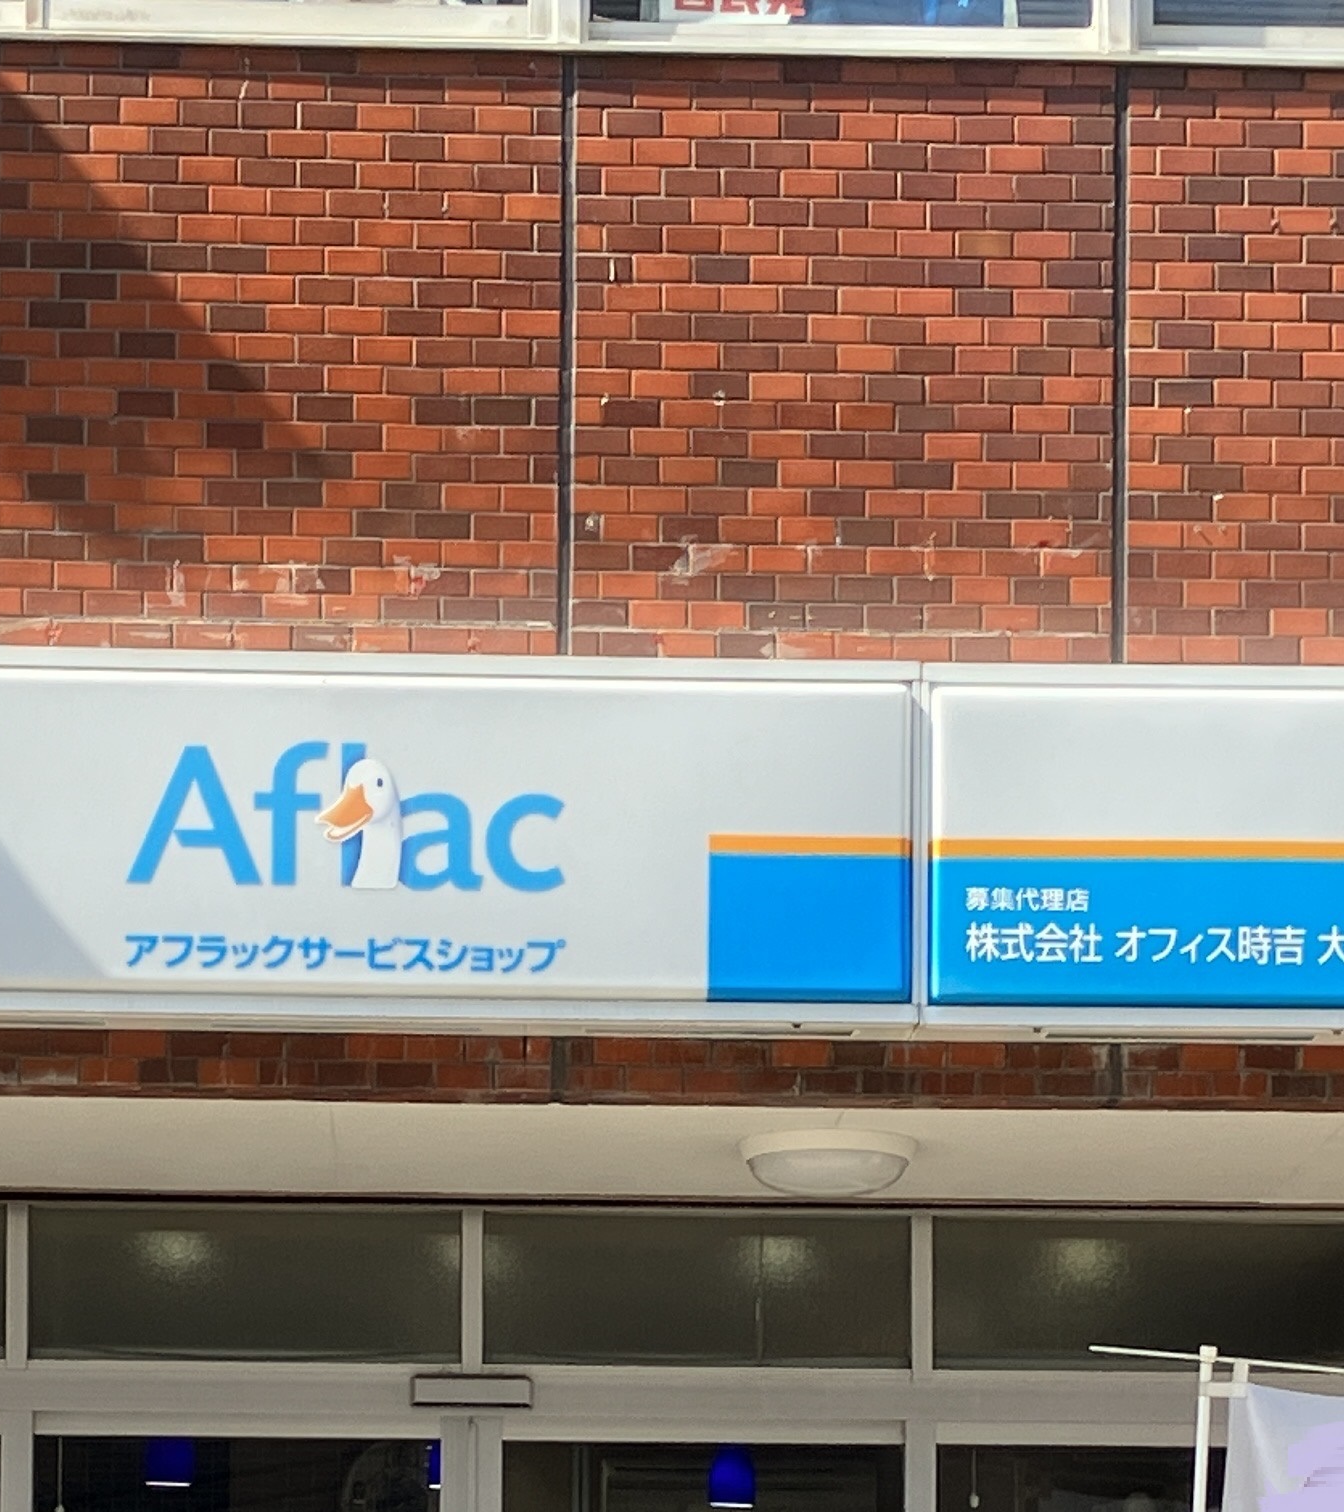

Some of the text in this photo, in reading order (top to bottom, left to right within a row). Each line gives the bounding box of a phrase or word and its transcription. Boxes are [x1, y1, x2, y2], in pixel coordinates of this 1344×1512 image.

[126, 740, 566, 893] Aflac
[964, 886, 1090, 914] 募集代理店
[124, 934, 566, 974] アフラックサービスショップ
[965, 921, 1103, 965] 株式会社
[1114, 924, 1306, 967] オフィス時吉
